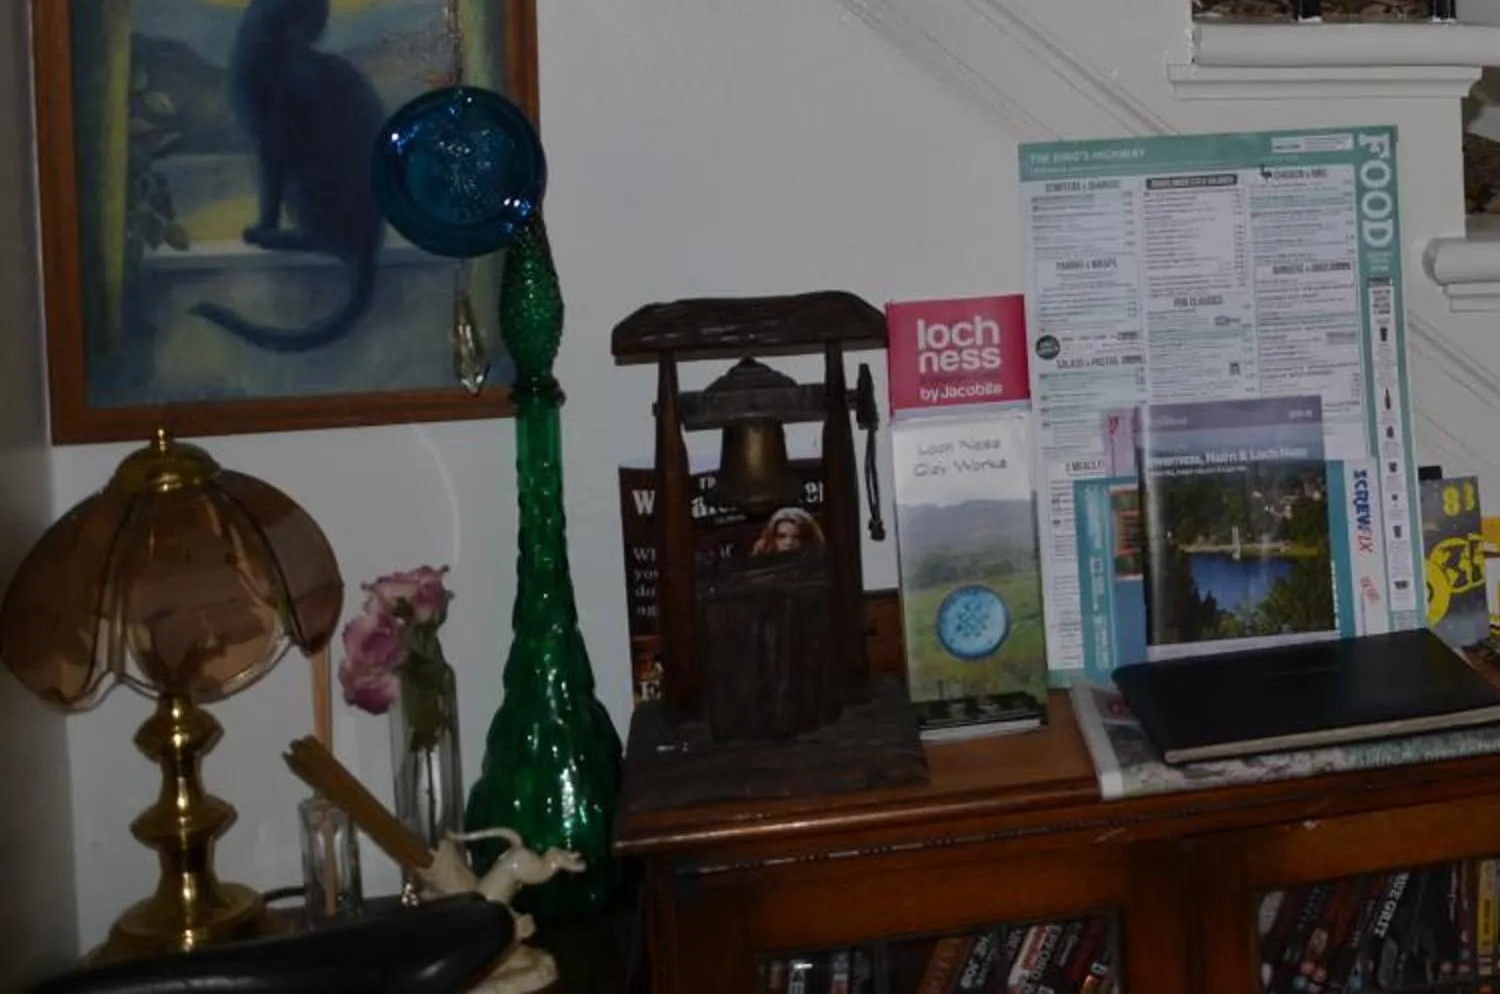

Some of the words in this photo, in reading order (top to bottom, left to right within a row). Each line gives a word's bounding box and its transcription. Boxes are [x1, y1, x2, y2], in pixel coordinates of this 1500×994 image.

[1358, 132, 1394, 248] FOOD
[916, 314, 1001, 350] loch
[918, 347, 1002, 374] ness
[920, 387, 939, 403] by
[1352, 469, 1374, 554] SCREWFIX
